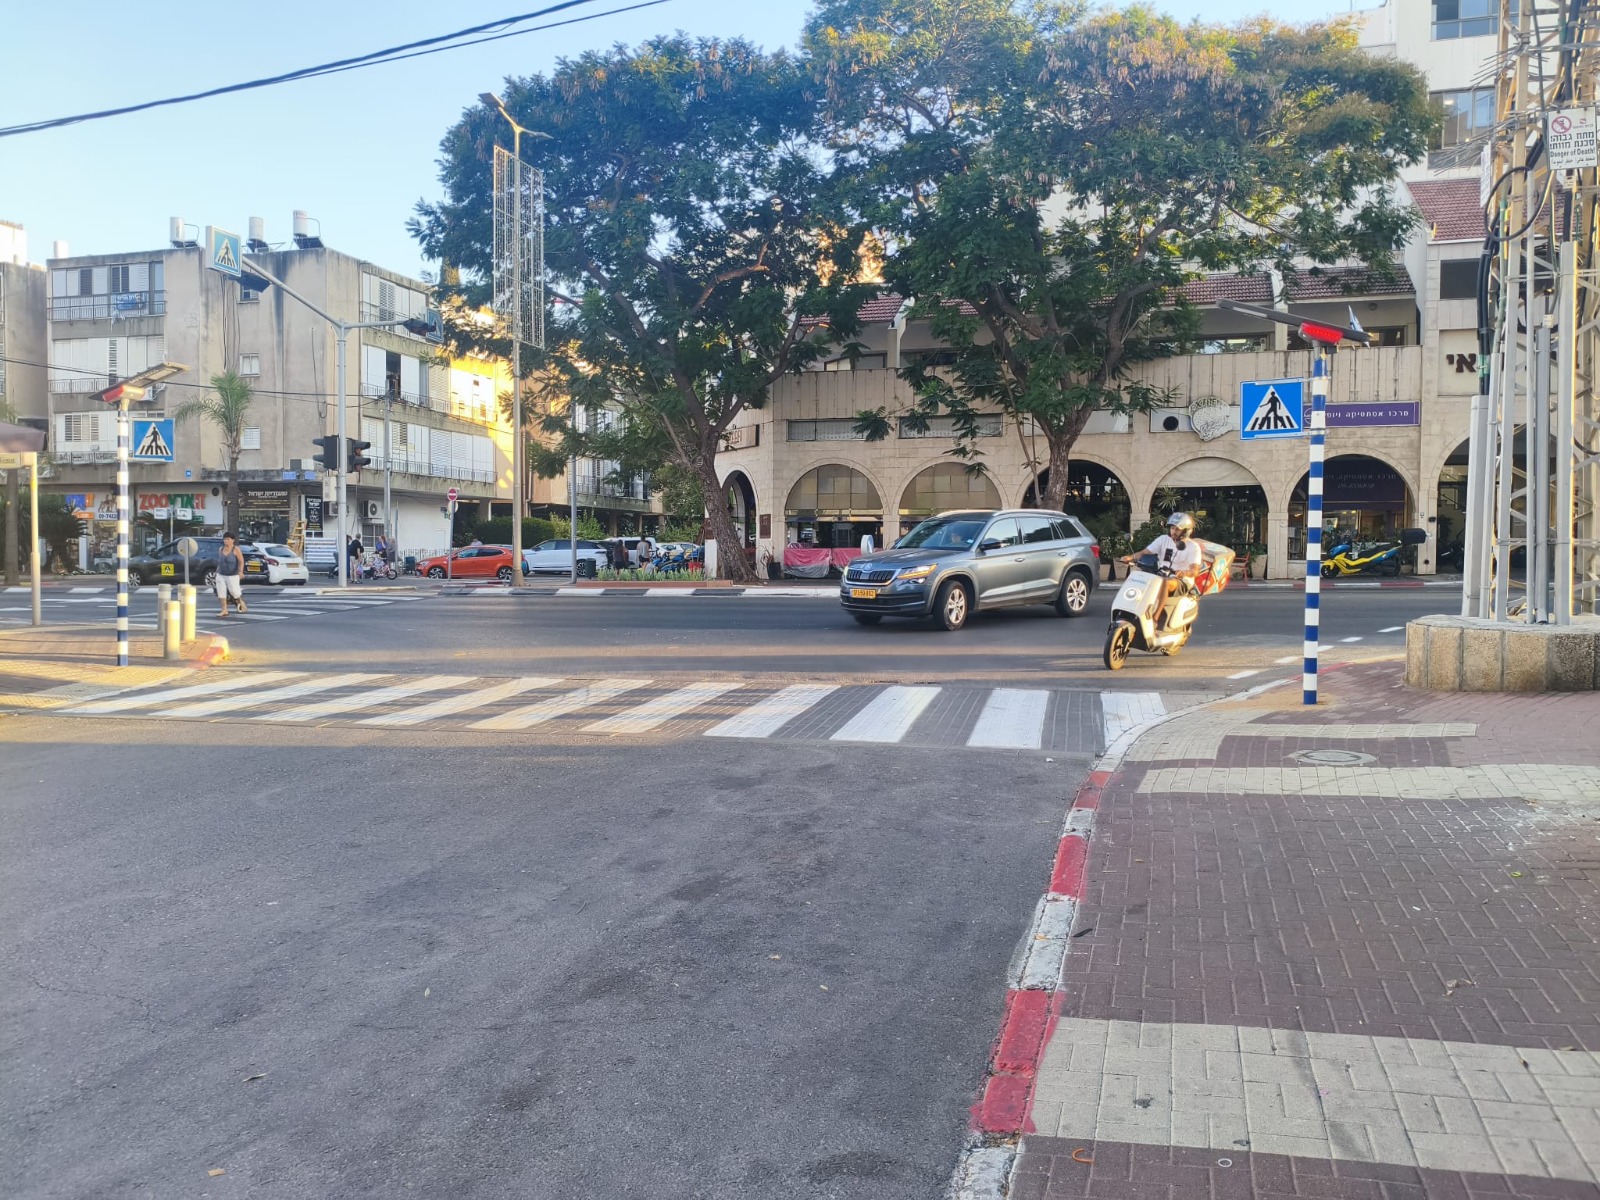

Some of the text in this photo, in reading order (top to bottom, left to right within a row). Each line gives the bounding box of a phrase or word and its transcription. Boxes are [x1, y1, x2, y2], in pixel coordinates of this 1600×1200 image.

[1576, 131, 1595, 140] מתח
[1574, 139, 1595, 148] סכנת
[1550, 150, 1569, 159] Danger
[1345, 410, 1384, 419] אסתטיקה
[1388, 410, 1409, 418] מרכז
[139, 493, 169, 510] ZOO
